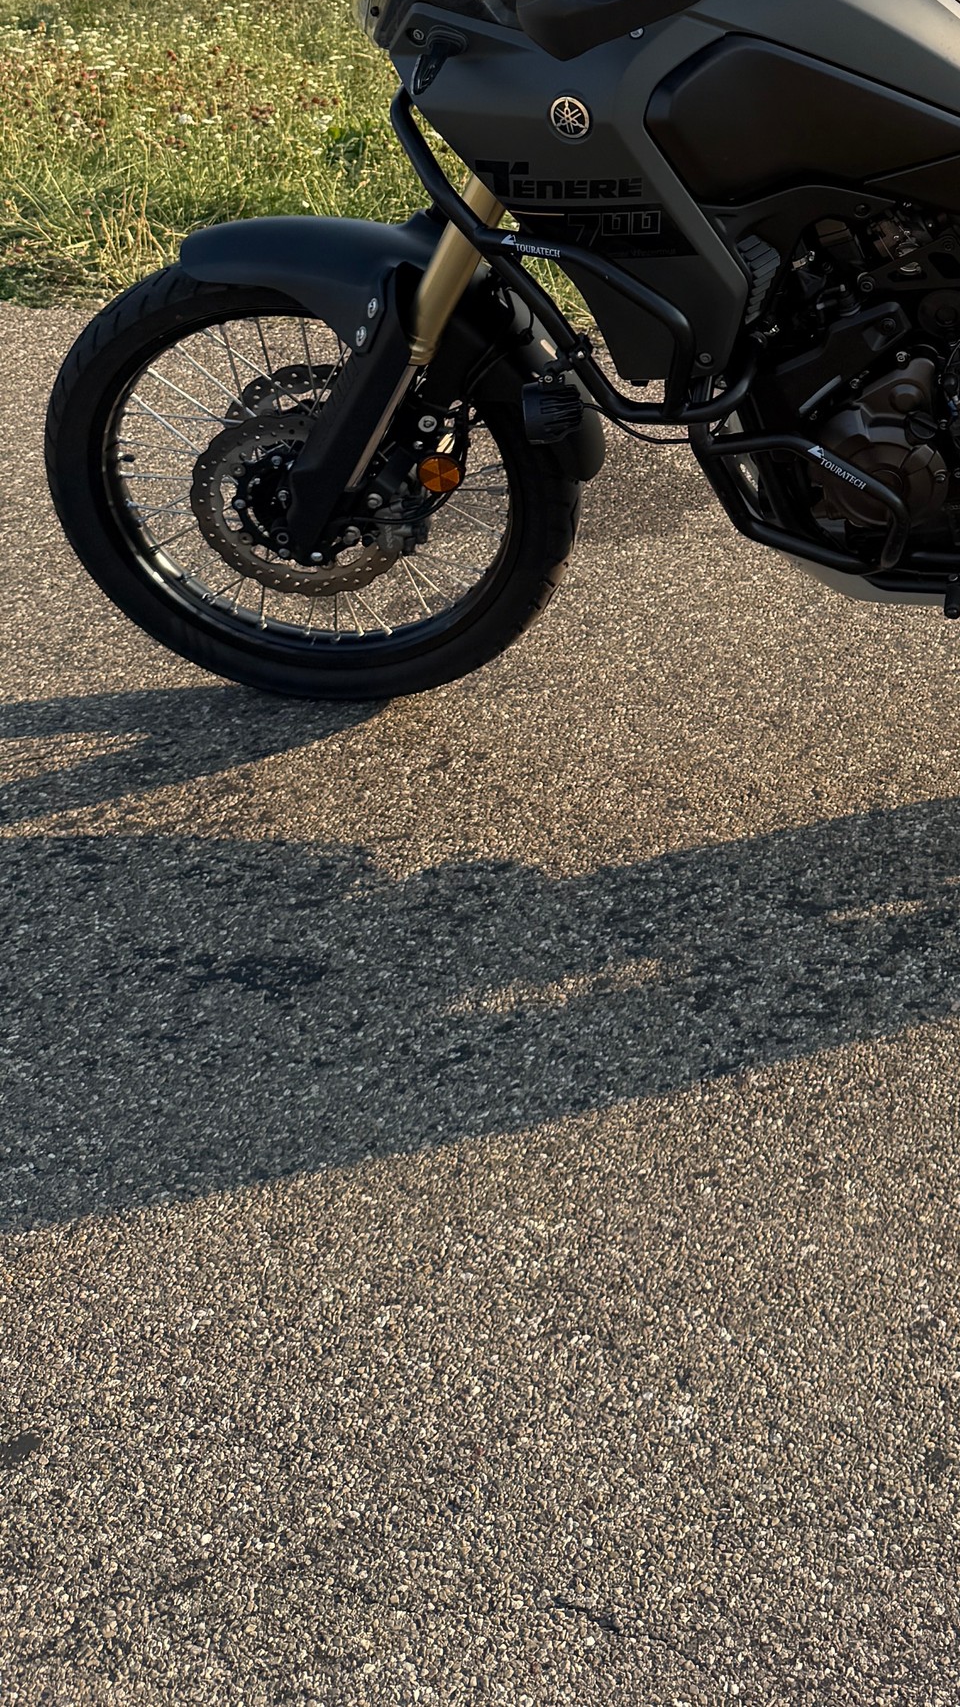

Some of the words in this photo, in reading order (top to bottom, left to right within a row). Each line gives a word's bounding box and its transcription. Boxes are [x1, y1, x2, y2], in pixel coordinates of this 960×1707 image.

[568, 211, 661, 246] 700
[514, 243, 561, 258] TOURATECH
[820, 457, 867, 490] TOURATECH
